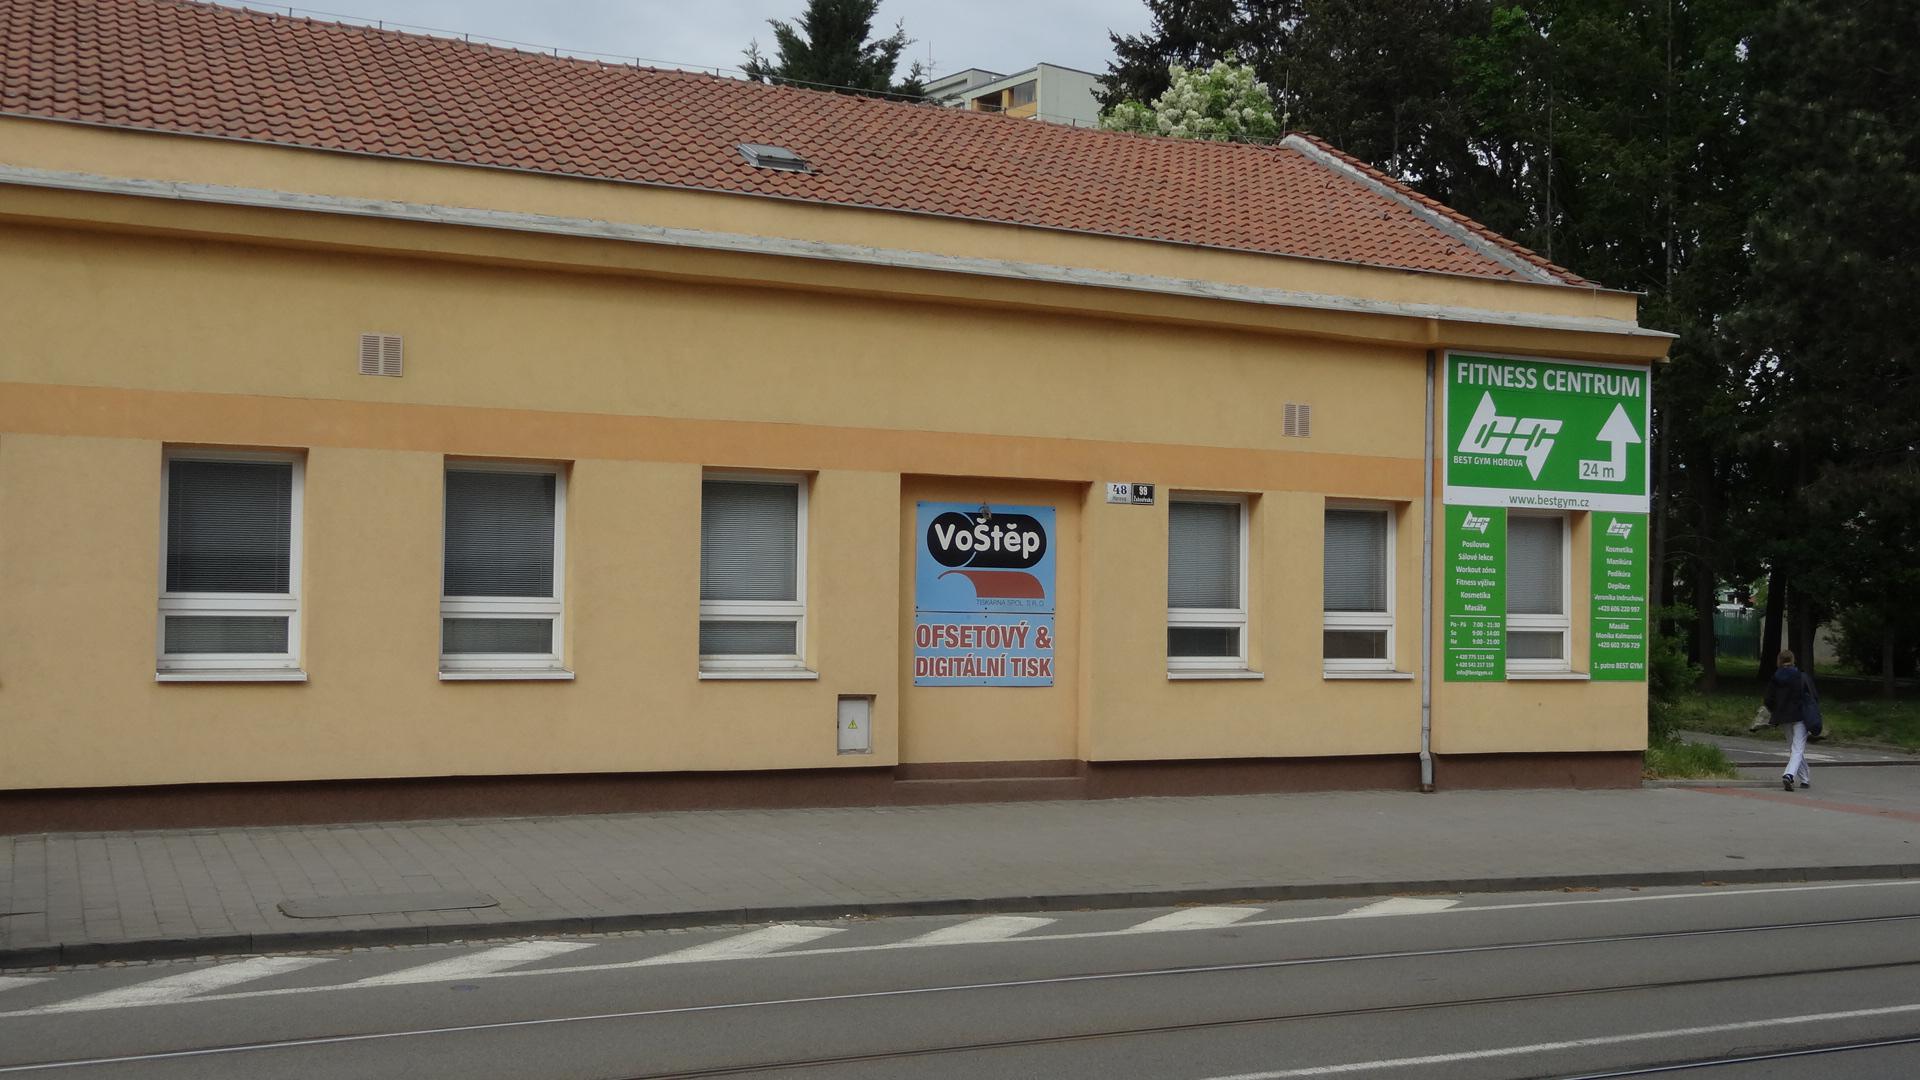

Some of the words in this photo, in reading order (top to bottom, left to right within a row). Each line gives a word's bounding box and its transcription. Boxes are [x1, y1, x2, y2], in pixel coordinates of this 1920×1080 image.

[1457, 362, 1537, 389] FITNESS
[1543, 369, 1640, 397] CENTRUM
[1453, 455, 1472, 465] BEST
[1474, 456, 1491, 466] GYM
[1492, 458, 1523, 467] HOROVA
[1582, 462, 1599, 478] 24
[1603, 466, 1615, 478] m
[1112, 484, 1127, 495] 48
[1138, 486, 1148, 496] 99
[1508, 493, 1589, 509] www.bestgym.cz
[934, 517, 1040, 560] VoŠtěp
[1462, 540, 1490, 549] Posilovna
[1605, 545, 1633, 553] Kosmetika
[1458, 552, 1478, 561] Sálové
[1478, 553, 1494, 561] lekce
[1481, 566, 1496, 574] zóna
[1455, 578, 1477, 586] Fitness
[1477, 579, 1496, 588] výživa
[1607, 582, 1631, 591] Depilace
[1460, 591, 1491, 599] Kosmetika
[1464, 604, 1487, 612] Masáže
[1608, 622, 1630, 630] Masáže
[915, 620, 1030, 649] OFSETOVÝ
[1034, 625, 1053, 649] &
[914, 653, 1007, 678] DIGITÁLNÍ
[1010, 656, 1053, 678] TISK
